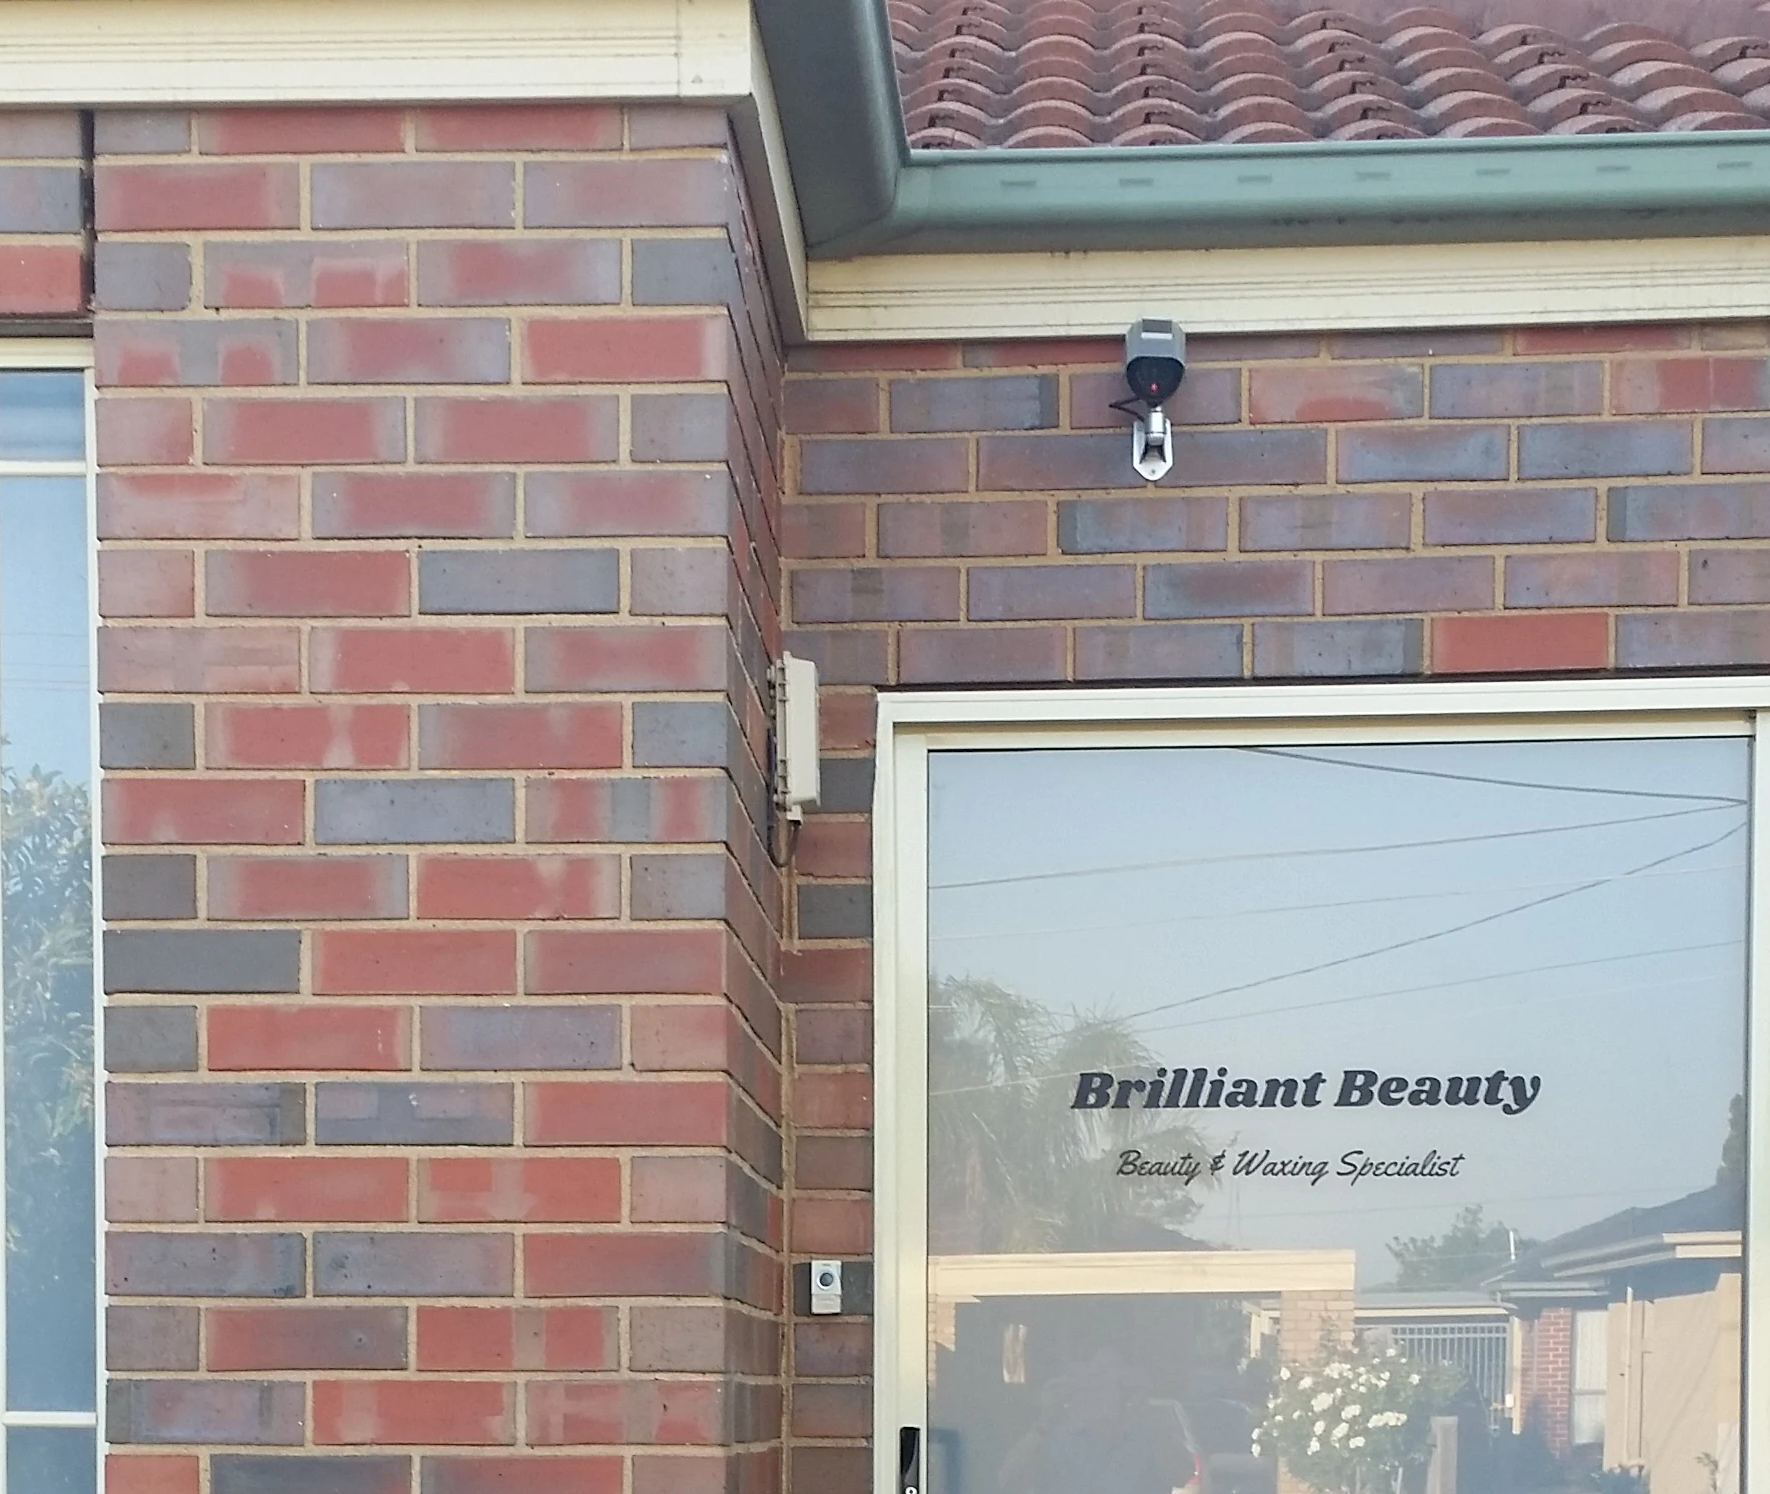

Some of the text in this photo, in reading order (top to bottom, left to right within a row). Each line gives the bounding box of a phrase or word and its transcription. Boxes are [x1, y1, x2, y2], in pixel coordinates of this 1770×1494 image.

[1070, 1068, 1541, 1116] Brilliant Beauty
[1116, 1149, 1466, 1186] Beauty & Waxing Specialist
